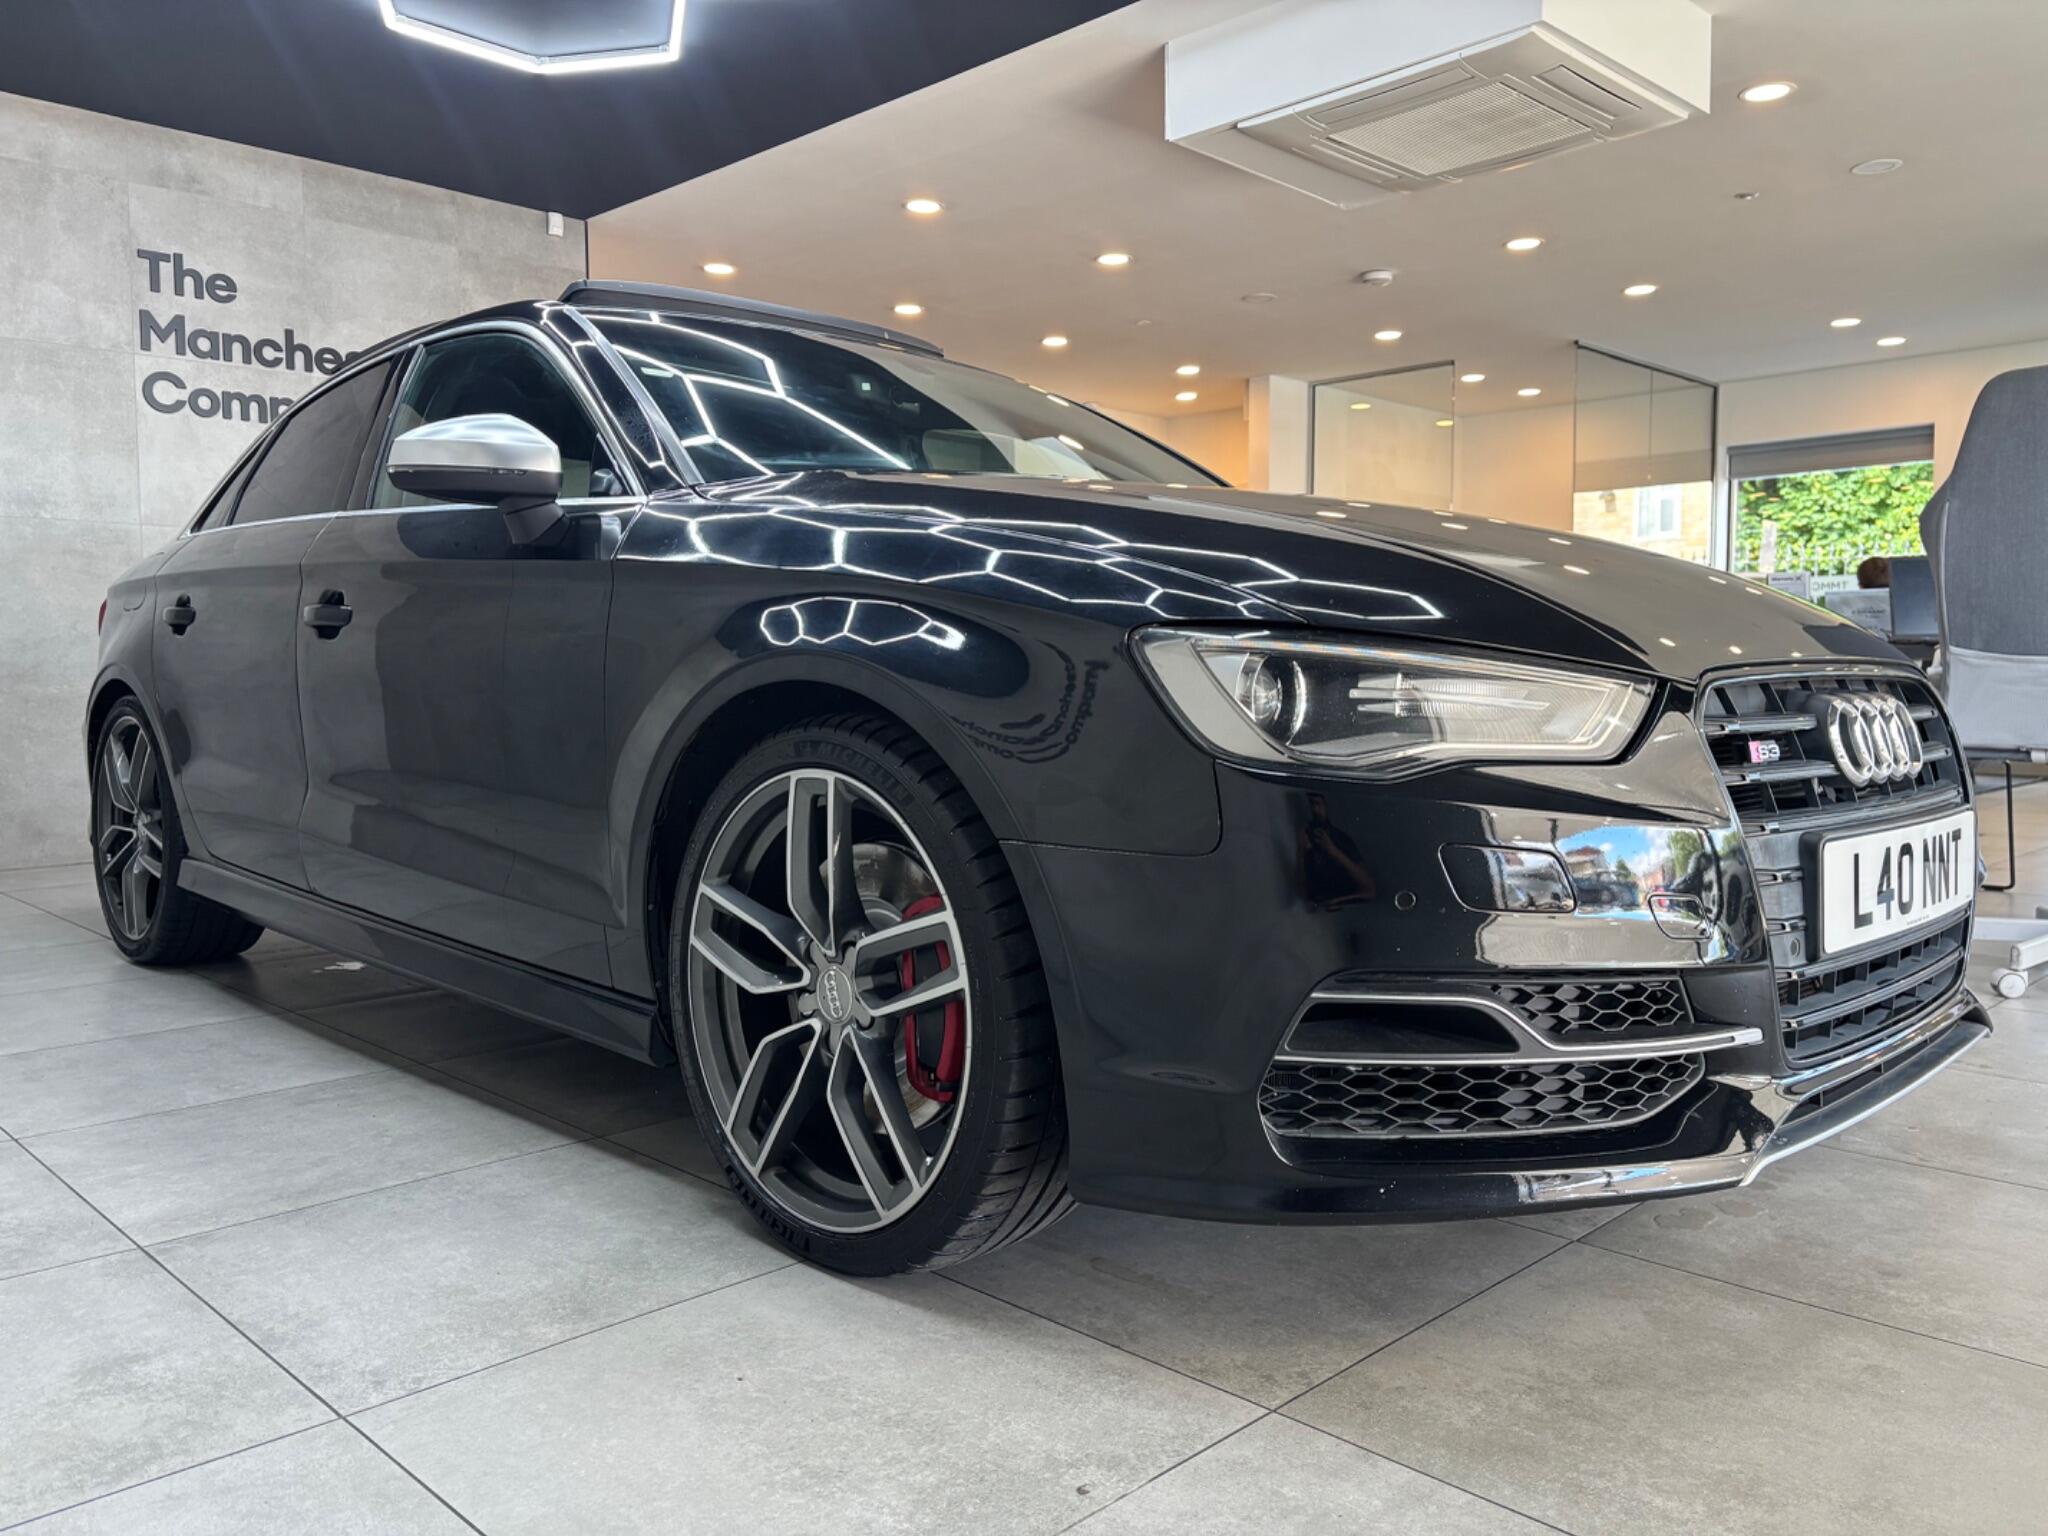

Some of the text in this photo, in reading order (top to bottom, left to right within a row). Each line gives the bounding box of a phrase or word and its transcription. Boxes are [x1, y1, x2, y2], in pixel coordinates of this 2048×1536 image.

[137, 248, 237, 303] The
[1853, 828, 1961, 930] L40 NNT
